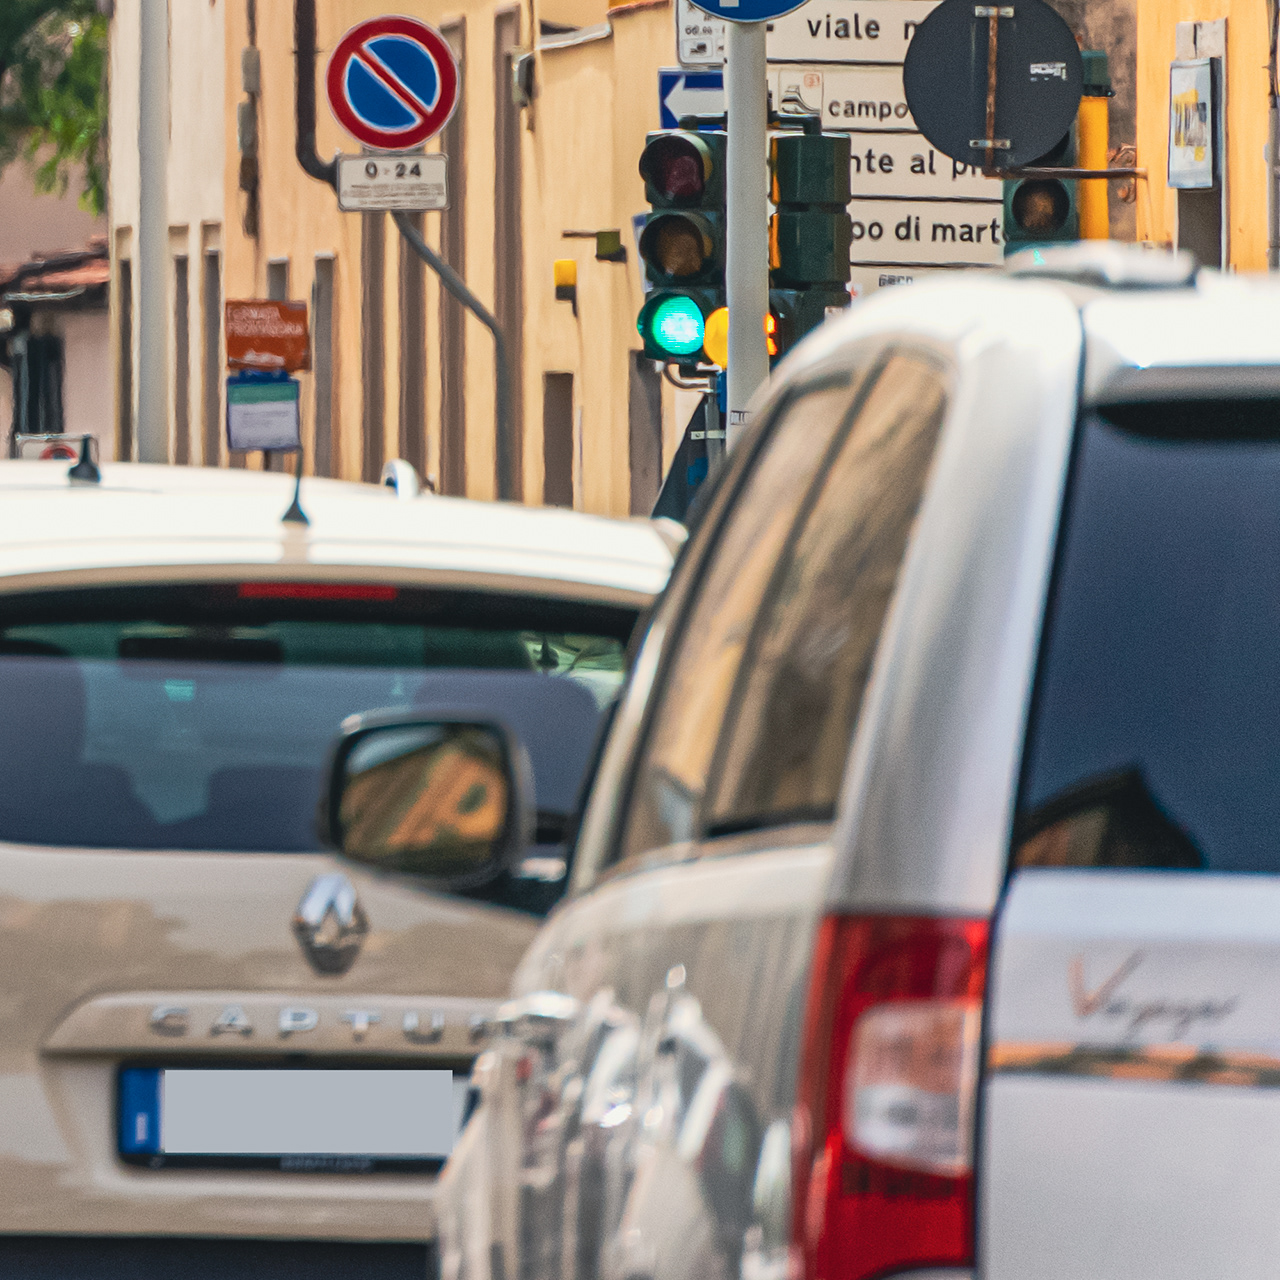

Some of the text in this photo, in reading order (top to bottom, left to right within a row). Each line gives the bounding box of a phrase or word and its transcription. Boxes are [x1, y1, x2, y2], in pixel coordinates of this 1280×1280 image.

[807, 13, 880, 40] viale
[828, 100, 908, 121] campo
[395, 162, 421, 177] 24
[910, 150, 936, 174] al
[895, 215, 920, 241] di
